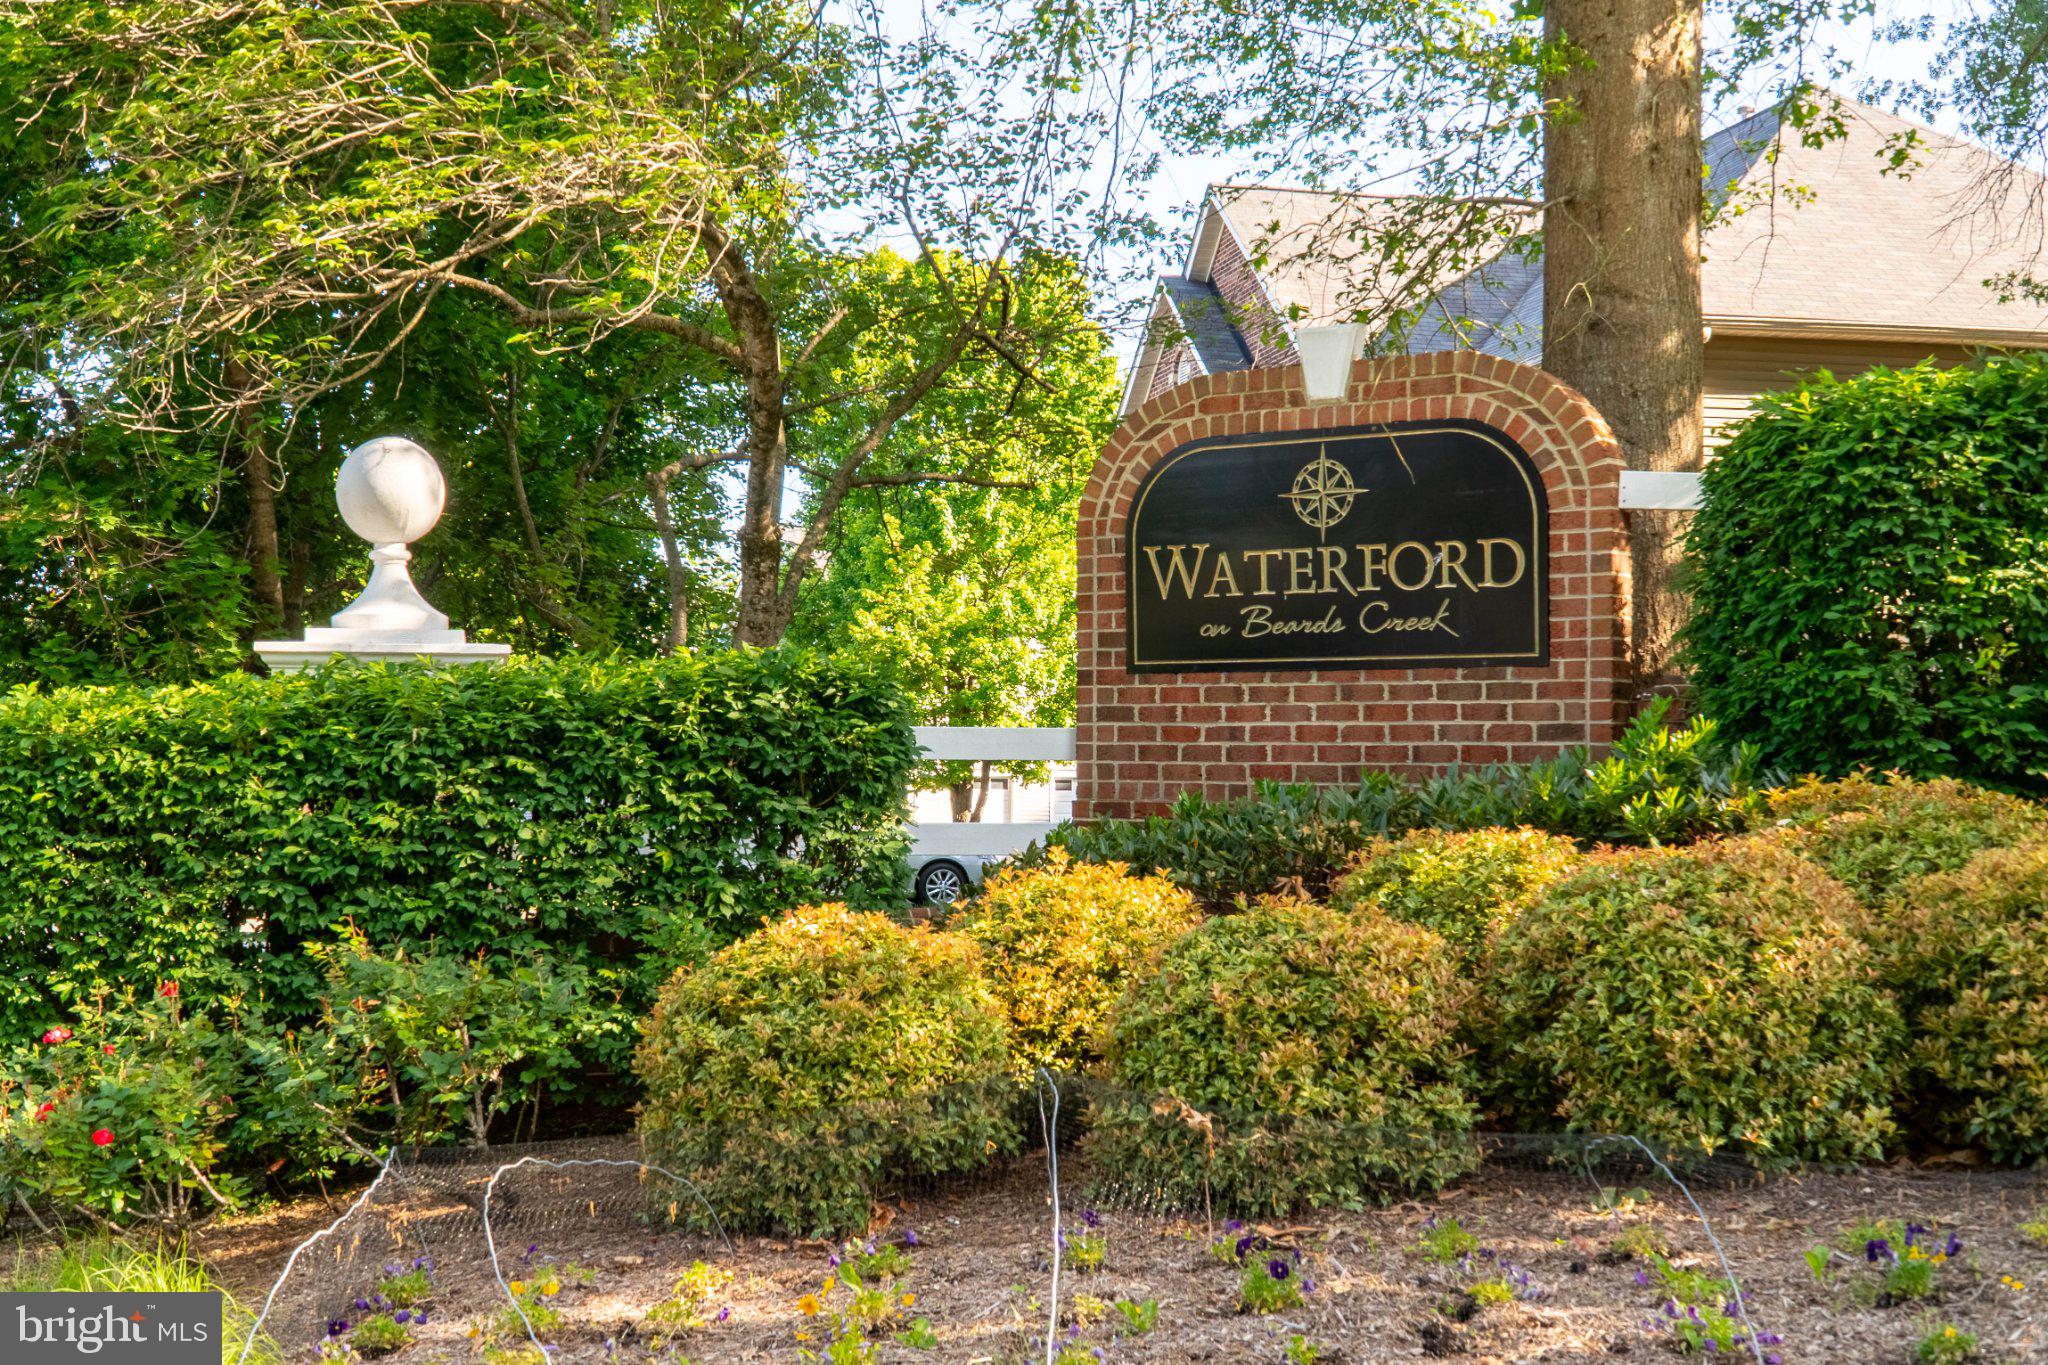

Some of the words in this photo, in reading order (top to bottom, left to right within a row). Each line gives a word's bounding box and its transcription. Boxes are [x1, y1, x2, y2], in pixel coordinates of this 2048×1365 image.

[1143, 538, 1526, 600] WATERFORD
[1200, 622, 1231, 638] on
[1240, 605, 1346, 638] Beards
[1359, 597, 1460, 638] Creek
